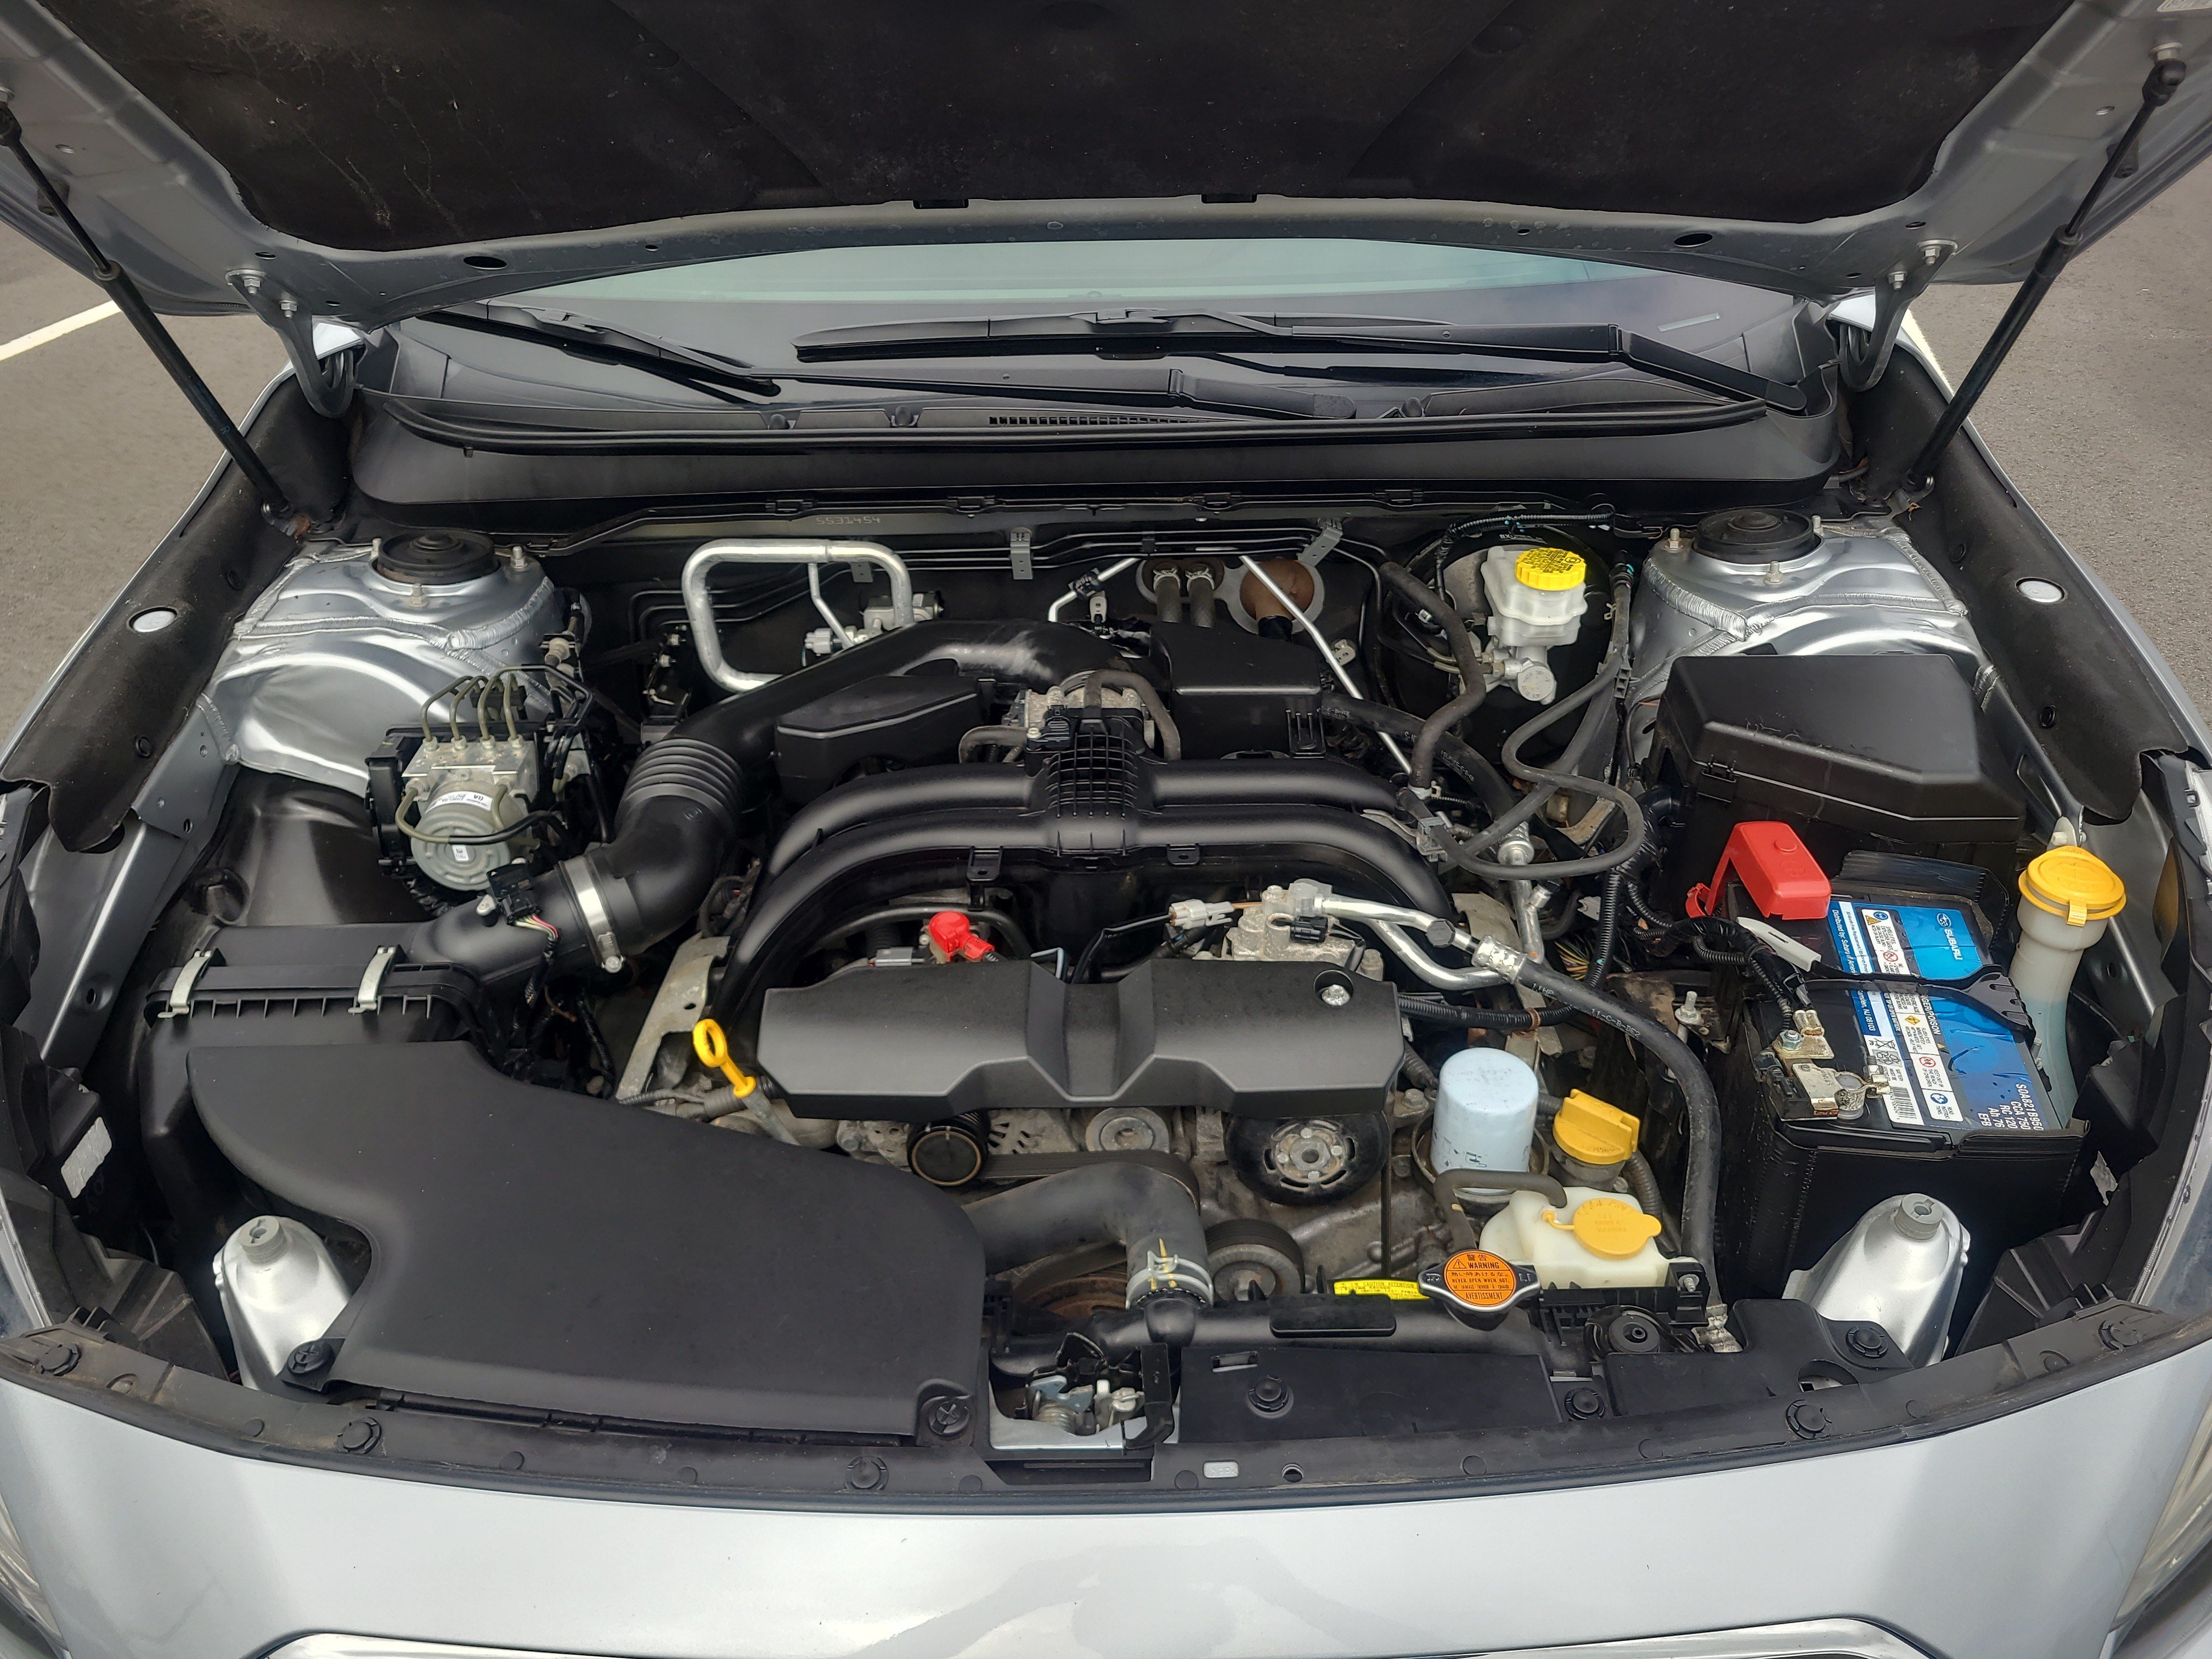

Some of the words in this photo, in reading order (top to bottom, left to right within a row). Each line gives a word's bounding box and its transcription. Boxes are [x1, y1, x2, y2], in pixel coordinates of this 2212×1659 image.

[1832, 910, 1844, 931] Distributed
[1841, 939, 1850, 954] Subaru
[1944, 929, 1962, 960] SUBARU
[1865, 1016, 1875, 1030] 08103
[1988, 1107, 2000, 1116] Ah
[1999, 1104, 2012, 1114] RC
[2011, 1101, 2024, 1115] CCA
[1978, 1113, 1991, 1126] EFB
[1993, 1119, 2005, 1127] 76
[2004, 1116, 2017, 1128] 120
[2017, 1117, 2030, 1129] 750
